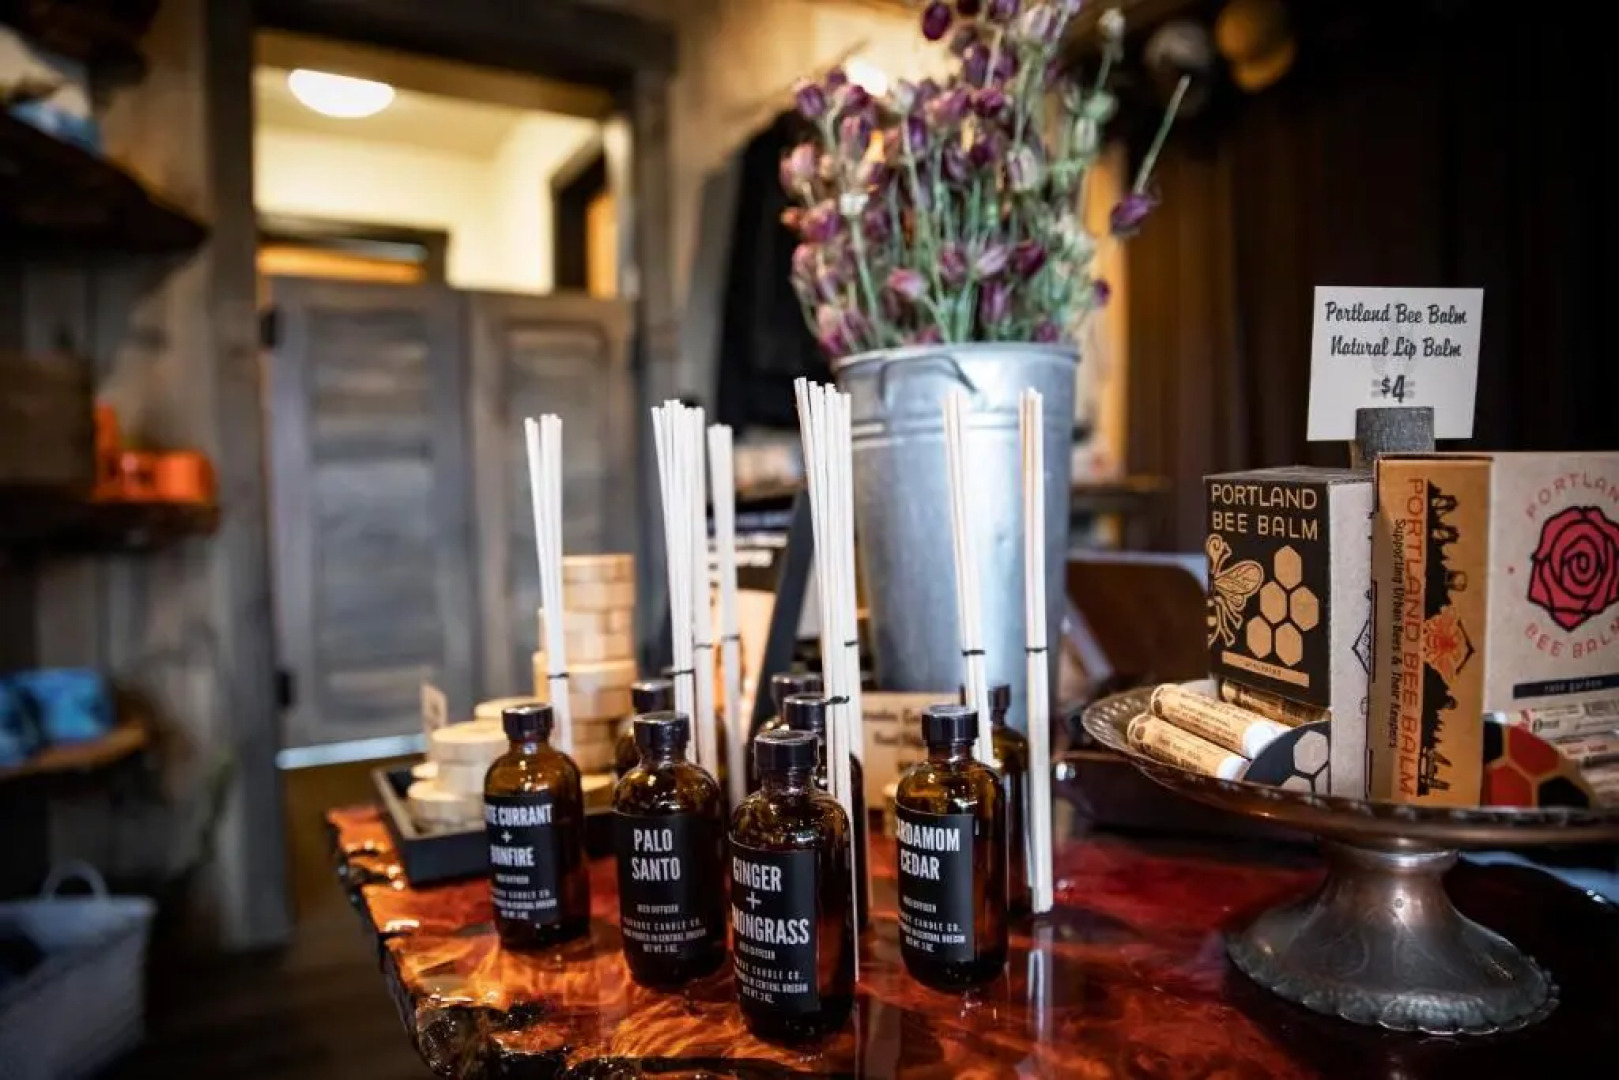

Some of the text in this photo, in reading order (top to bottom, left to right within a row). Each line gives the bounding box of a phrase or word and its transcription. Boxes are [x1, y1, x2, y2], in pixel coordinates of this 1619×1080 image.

[1325, 301, 1468, 325] Portland Bee Balm
[1330, 335, 1462, 361] Natural Lip Balm
[1381, 374, 1406, 403] $4
[1211, 484, 1319, 510] PORTLAND
[1212, 511, 1319, 542] BEE BALM
[1392, 518, 1406, 584] Supporting
[1397, 478, 1424, 797] PORTLAND BEE BALM
[1524, 622, 1565, 658] BEE
[498, 803, 553, 827] CURRANT
[633, 828, 673, 852] PALO
[631, 856, 681, 882] SANTO
[732, 855, 782, 892] GINGER
[900, 847, 941, 882] CEDAR
